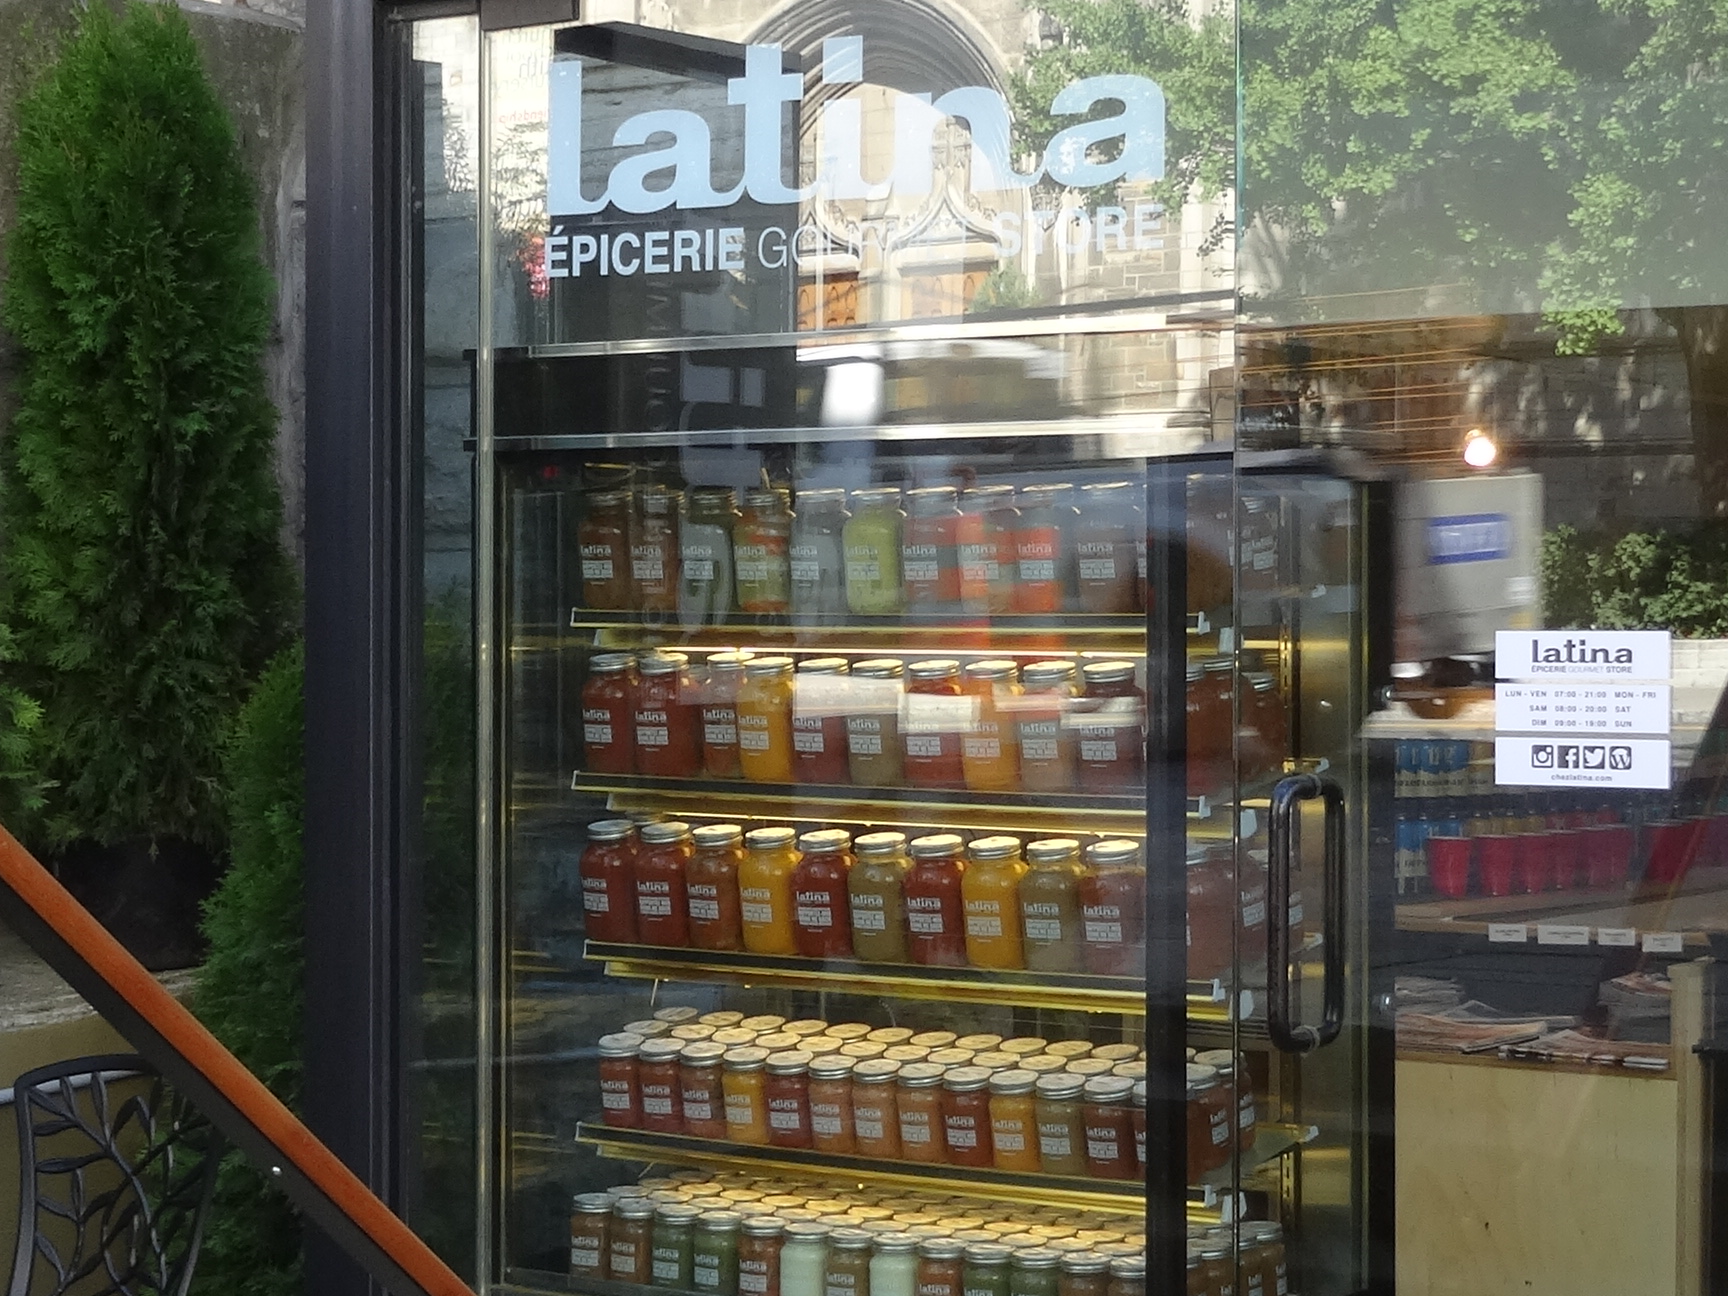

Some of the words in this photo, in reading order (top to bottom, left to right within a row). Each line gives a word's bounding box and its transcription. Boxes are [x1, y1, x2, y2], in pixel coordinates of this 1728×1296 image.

[546, 34, 1168, 217] latina
[543, 226, 746, 281] ÉPICERIE
[992, 203, 1165, 259] STORE
[1531, 639, 1633, 664] latina
[1605, 665, 1633, 674] STORE
[1505, 690, 1523, 698] LUN
[1530, 690, 1547, 698] VEN
[1554, 691, 1577, 699] 07:00
[1584, 691, 1607, 699] 21:00
[1614, 691, 1635, 699] MON
[1642, 691, 1657, 699] FRI
[1529, 704, 1548, 712] SAM
[1615, 705, 1632, 713] SAT
[1614, 720, 1633, 728] SUN
[1550, 773, 1613, 782] chezlatina.com
[582, 878, 606, 890] latina
[637, 881, 669, 893] latina
[687, 884, 716, 896] latina
[740, 888, 770, 900] latina
[796, 891, 830, 903] latina
[851, 894, 883, 906] latina
[907, 897, 941, 910] latina
[965, 899, 999, 913] latina
[1024, 903, 1059, 916] latina
[1084, 905, 1120, 918] latina
[601, 1080, 628, 1091] latina
[642, 1084, 670, 1096] latina
[683, 1088, 709, 1101] latina
[725, 1094, 751, 1106] latina
[769, 1098, 797, 1111] latina
[811, 1103, 839, 1115] latina
[855, 1107, 881, 1120] latina
[900, 1111, 928, 1123] latina
[945, 1114, 974, 1128] latina
[993, 1119, 1022, 1132] latina
[1038, 1123, 1068, 1136] latina
[1086, 1127, 1116, 1140] latina
